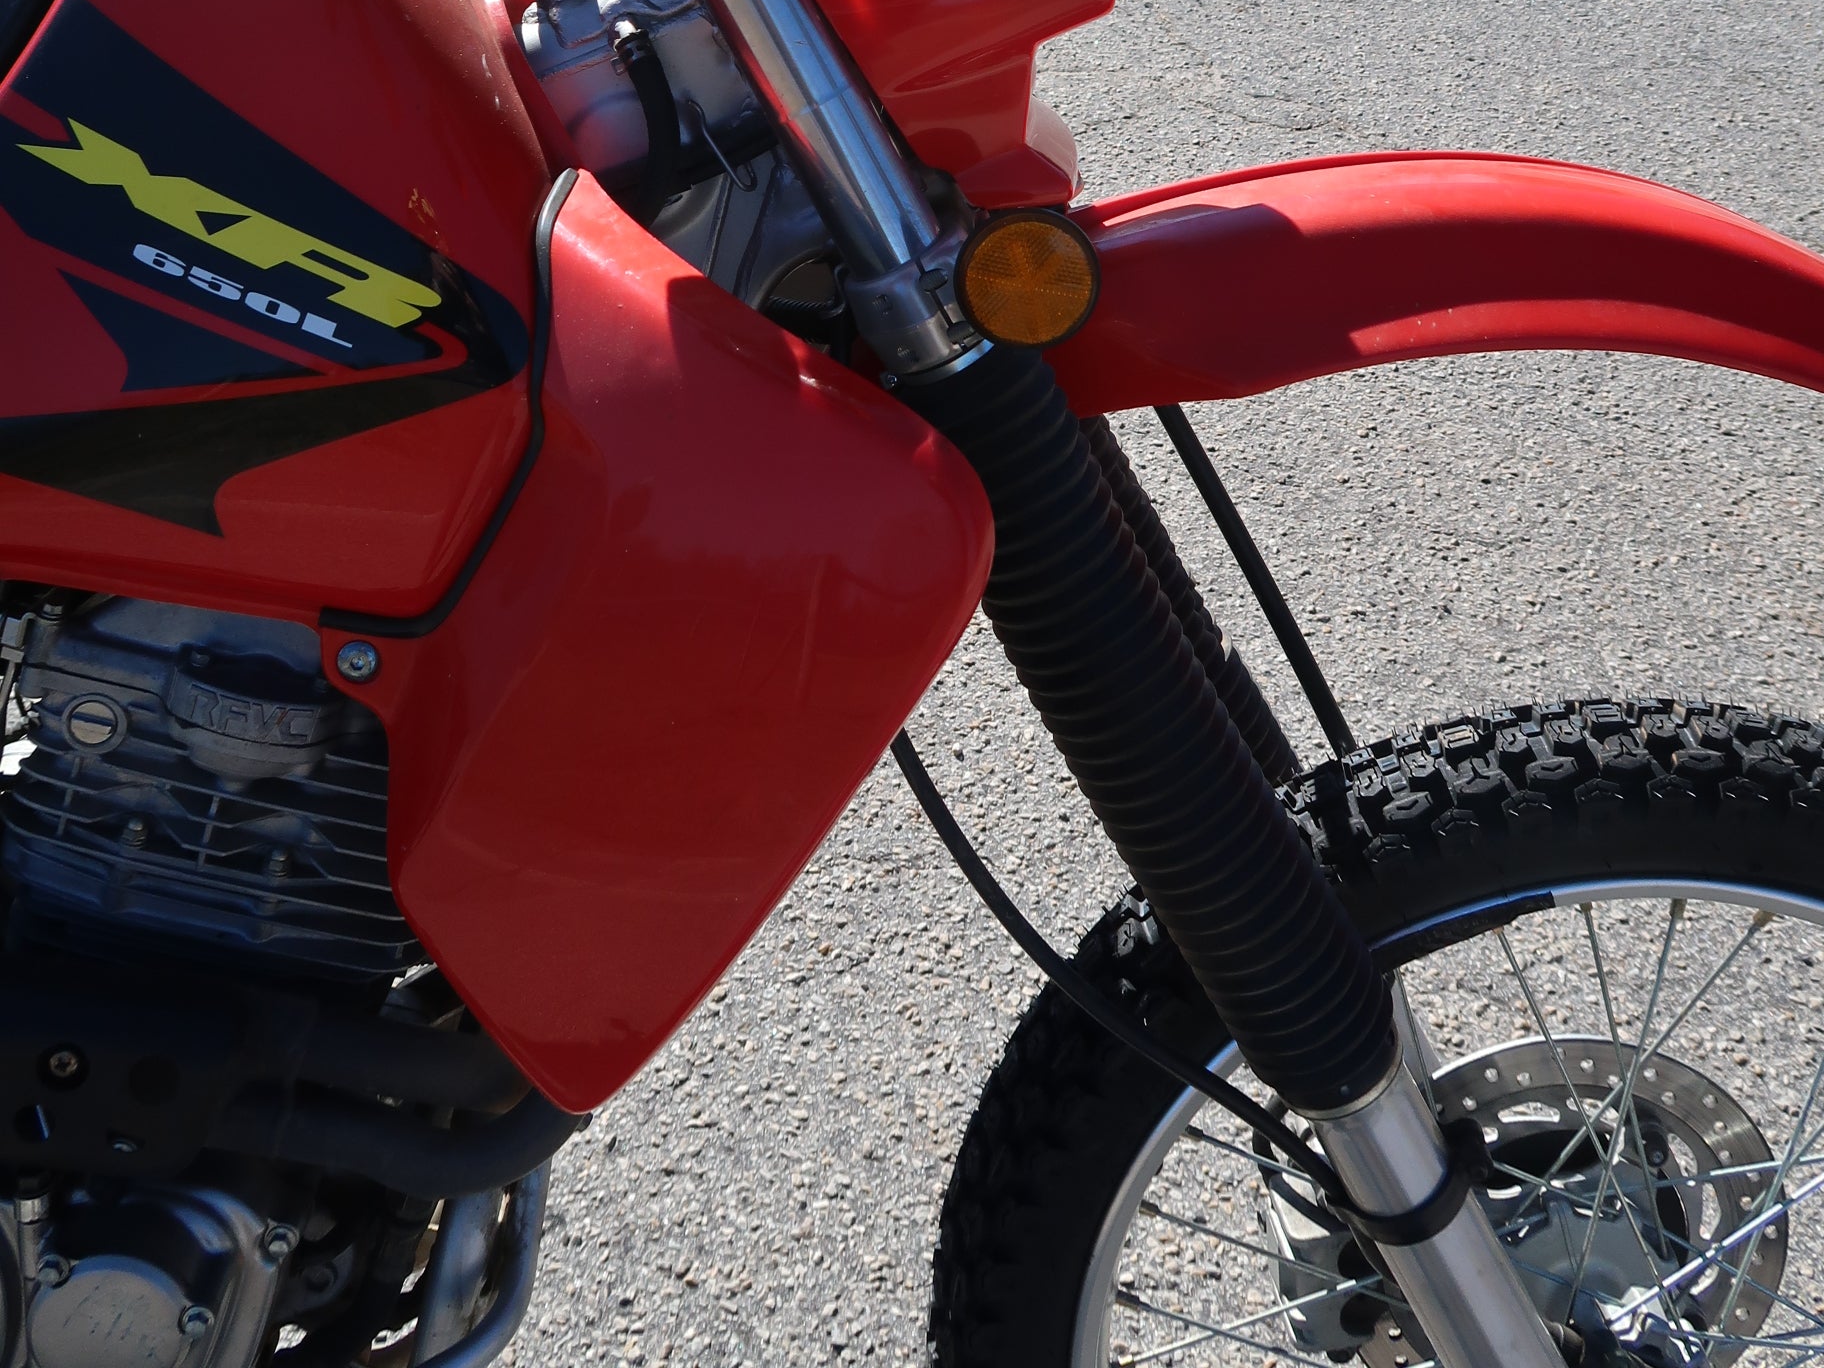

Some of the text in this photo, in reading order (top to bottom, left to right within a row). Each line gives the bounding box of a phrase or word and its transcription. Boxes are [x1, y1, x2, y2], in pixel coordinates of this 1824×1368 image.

[15, 117, 442, 328] XR
[133, 243, 353, 348] 650L
[188, 684, 314, 744] RFVC
